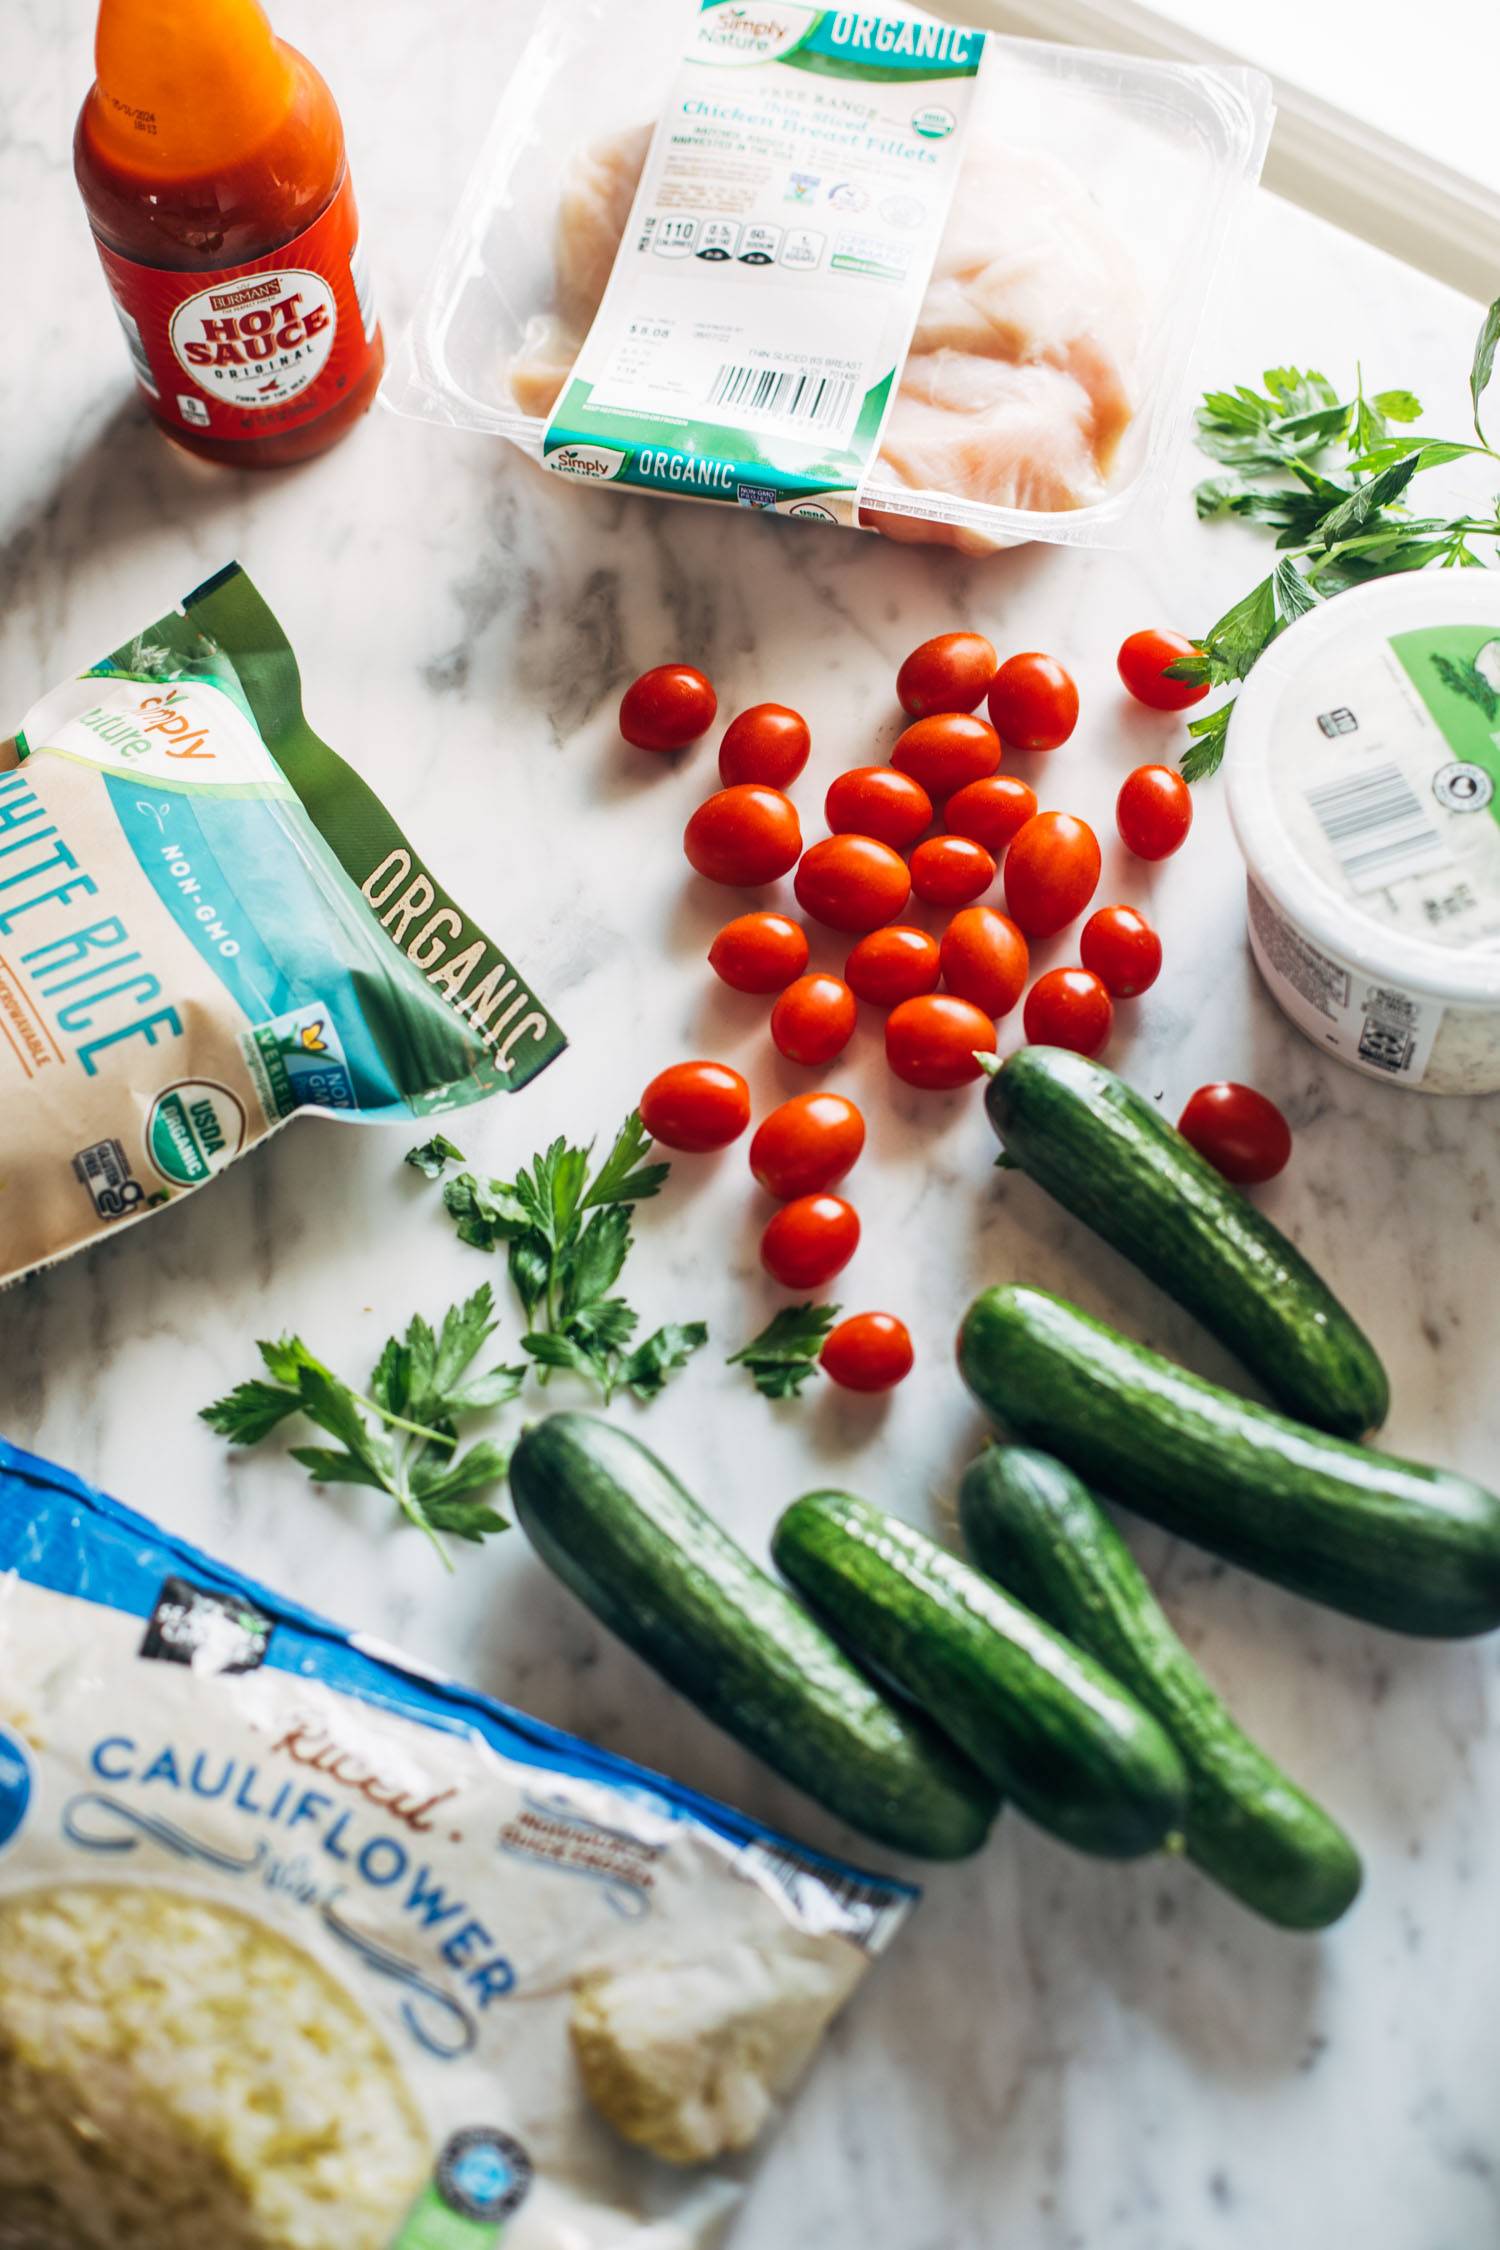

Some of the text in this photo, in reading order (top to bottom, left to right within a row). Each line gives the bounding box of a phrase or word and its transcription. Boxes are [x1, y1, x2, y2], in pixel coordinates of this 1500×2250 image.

[698, 29, 769, 51] Nature
[718, 12, 788, 39] Simply
[831, 11, 971, 63] ORGANIC
[682, 100, 774, 127] Chicken
[782, 119, 859, 146] Breast
[866, 137, 938, 164] Fillets
[666, 222, 694, 239] 110
[200, 292, 304, 343] HOT
[211, 280, 281, 311] BURMAN'S
[183, 304, 330, 368] SAUCE
[214, 344, 313, 379] ORIGINAL
[557, 449, 736, 489] Simply ORGANIC
[161, 844, 240, 958] NON-GMO
[361, 848, 548, 1073] ORGANIC
[20, 914, 184, 1078] RICE
[161, 1104, 203, 1177] ORGANIC
[189, 1098, 227, 1157] USDA
[89, 1735, 518, 2012] CAULIFLOWER
